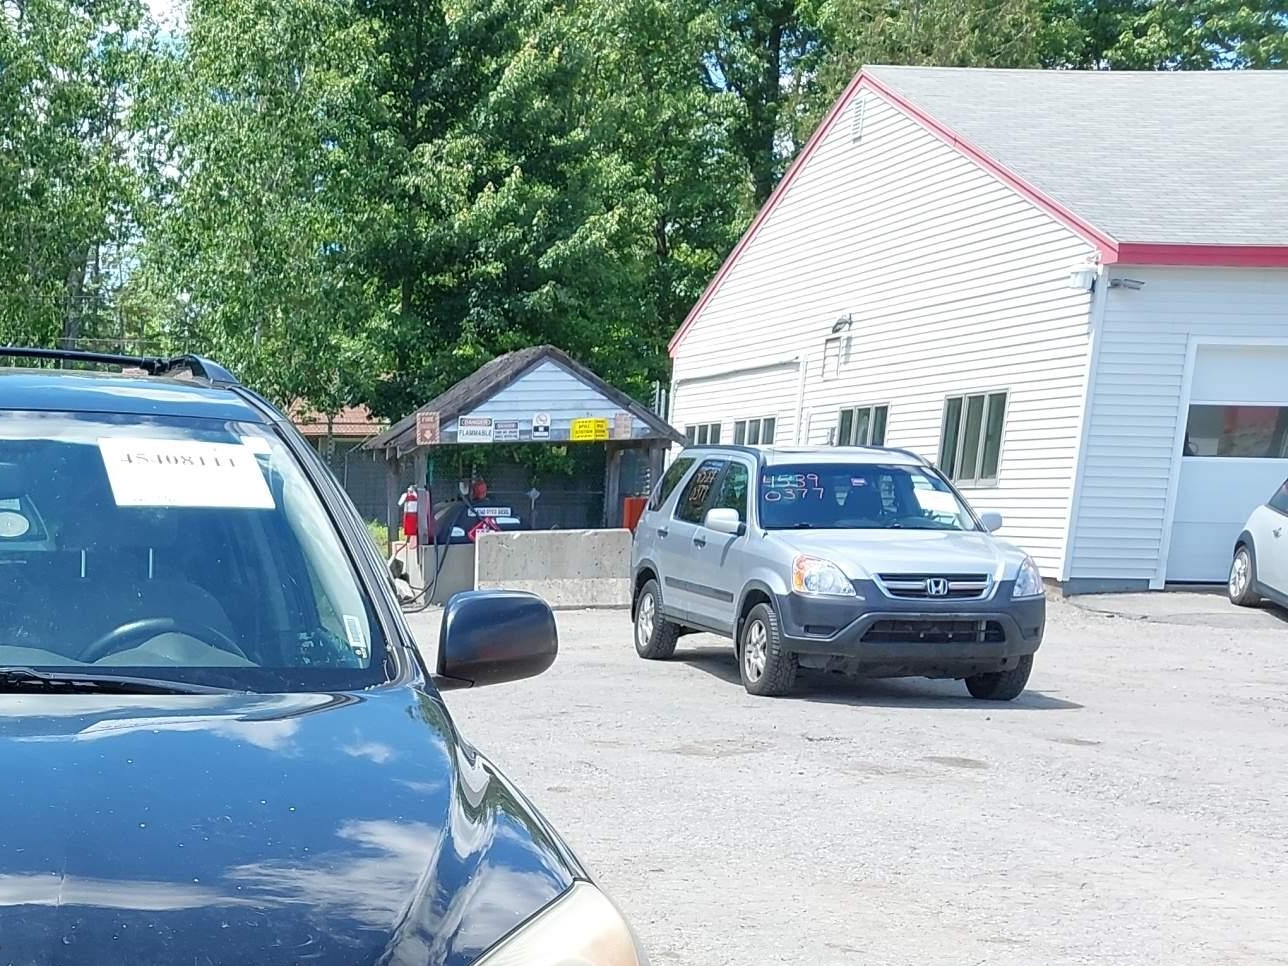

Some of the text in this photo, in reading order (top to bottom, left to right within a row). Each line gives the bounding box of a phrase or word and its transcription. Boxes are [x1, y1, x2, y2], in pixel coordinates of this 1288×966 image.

[459, 429, 492, 437] FLAMMABLE
[762, 473, 819, 488] 4539
[765, 487, 824, 502] 0377
